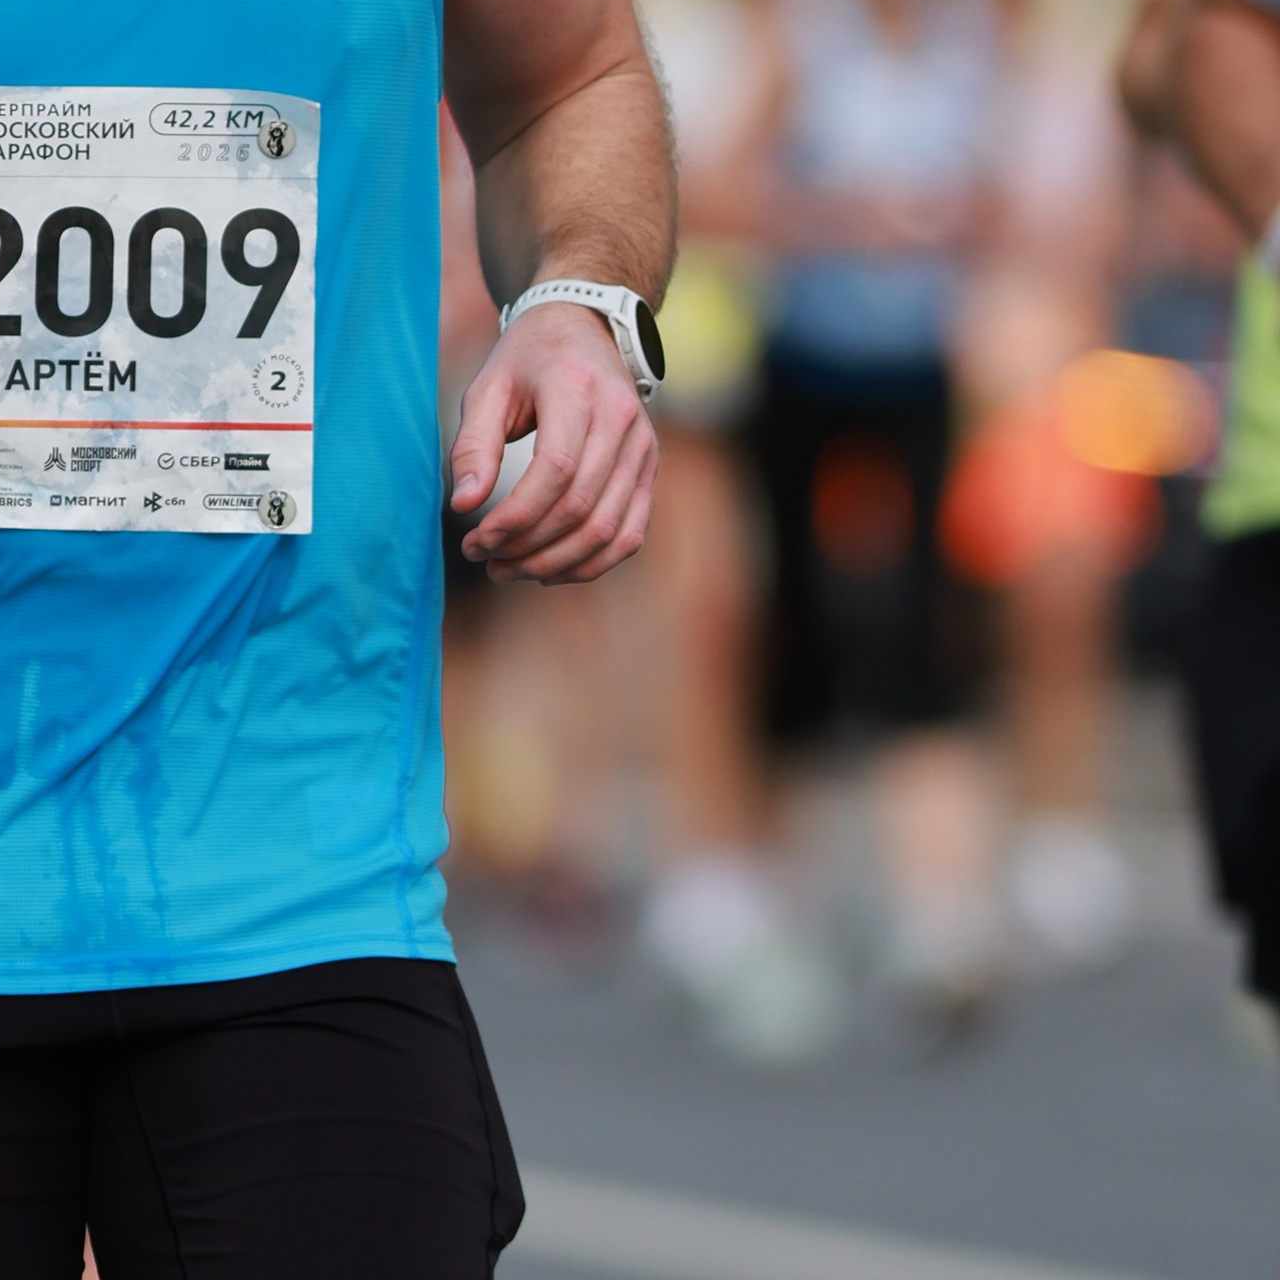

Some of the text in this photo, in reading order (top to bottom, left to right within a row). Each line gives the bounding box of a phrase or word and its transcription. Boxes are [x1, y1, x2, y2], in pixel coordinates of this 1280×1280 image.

[164, 110, 264, 131] 42,2 КМ
[177, 142, 250, 162] 2026
[4, 351, 137, 392] АРТЁМ
[270, 370, 286, 391] 2
[70, 445, 137, 460] МОСКОВСКИЙ
[70, 460, 102, 472] СПОРТ
[179, 456, 262, 467] СБЕР Прайм
[165, 497, 186, 506] сбп
[208, 498, 253, 507] WINLINE
